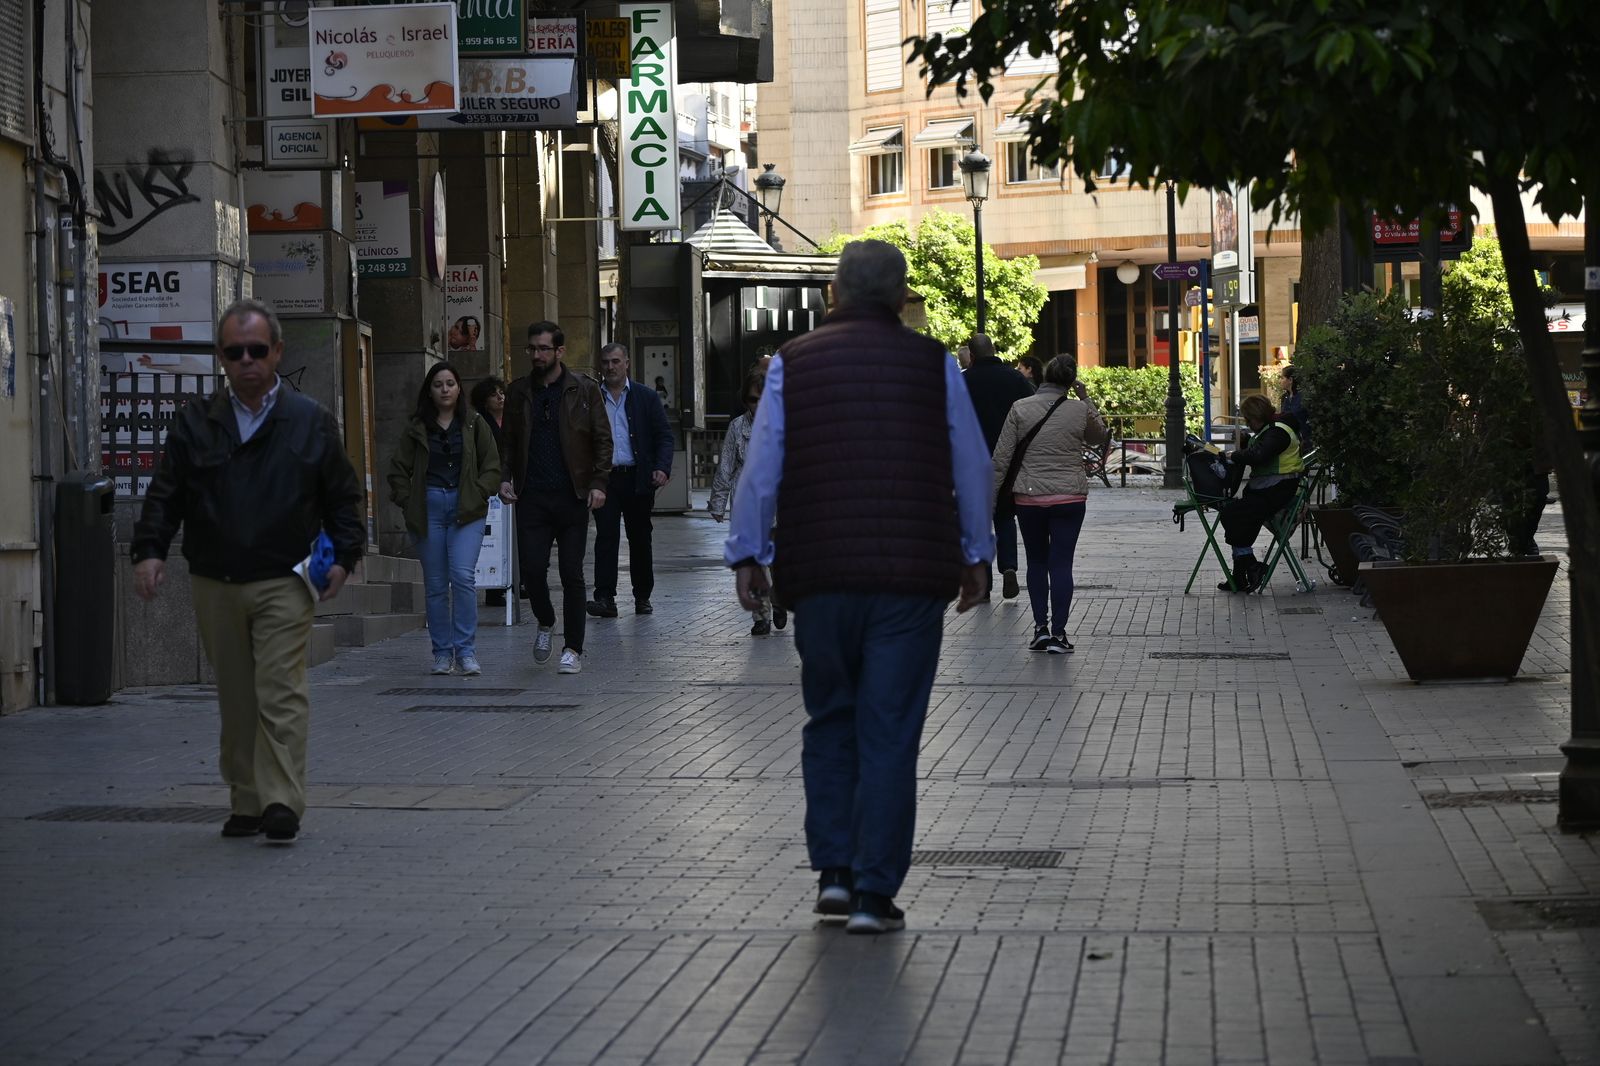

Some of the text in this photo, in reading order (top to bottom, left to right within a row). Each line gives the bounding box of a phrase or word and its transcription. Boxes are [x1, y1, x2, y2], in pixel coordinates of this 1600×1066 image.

[316, 27, 377, 45] Nicolás
[402, 24, 448, 42] Israel
[466, 36, 518, 45] 959 26 16 55
[366, 50, 415, 59] PELUQUEROS
[500, 97, 561, 110] SEGURO
[466, 114, 487, 123] 959
[507, 114, 518, 122] 27
[522, 114, 536, 122] 70
[628, 9, 670, 222] FARMACIA
[278, 131, 322, 142] AGENCIA
[280, 144, 319, 153] OFICIAL
[357, 246, 399, 257] CLÍNICOS
[367, 263, 386, 273] 248
[388, 262, 407, 272] 923
[111, 271, 180, 294] SEAG
[138, 295, 164, 303] Española
